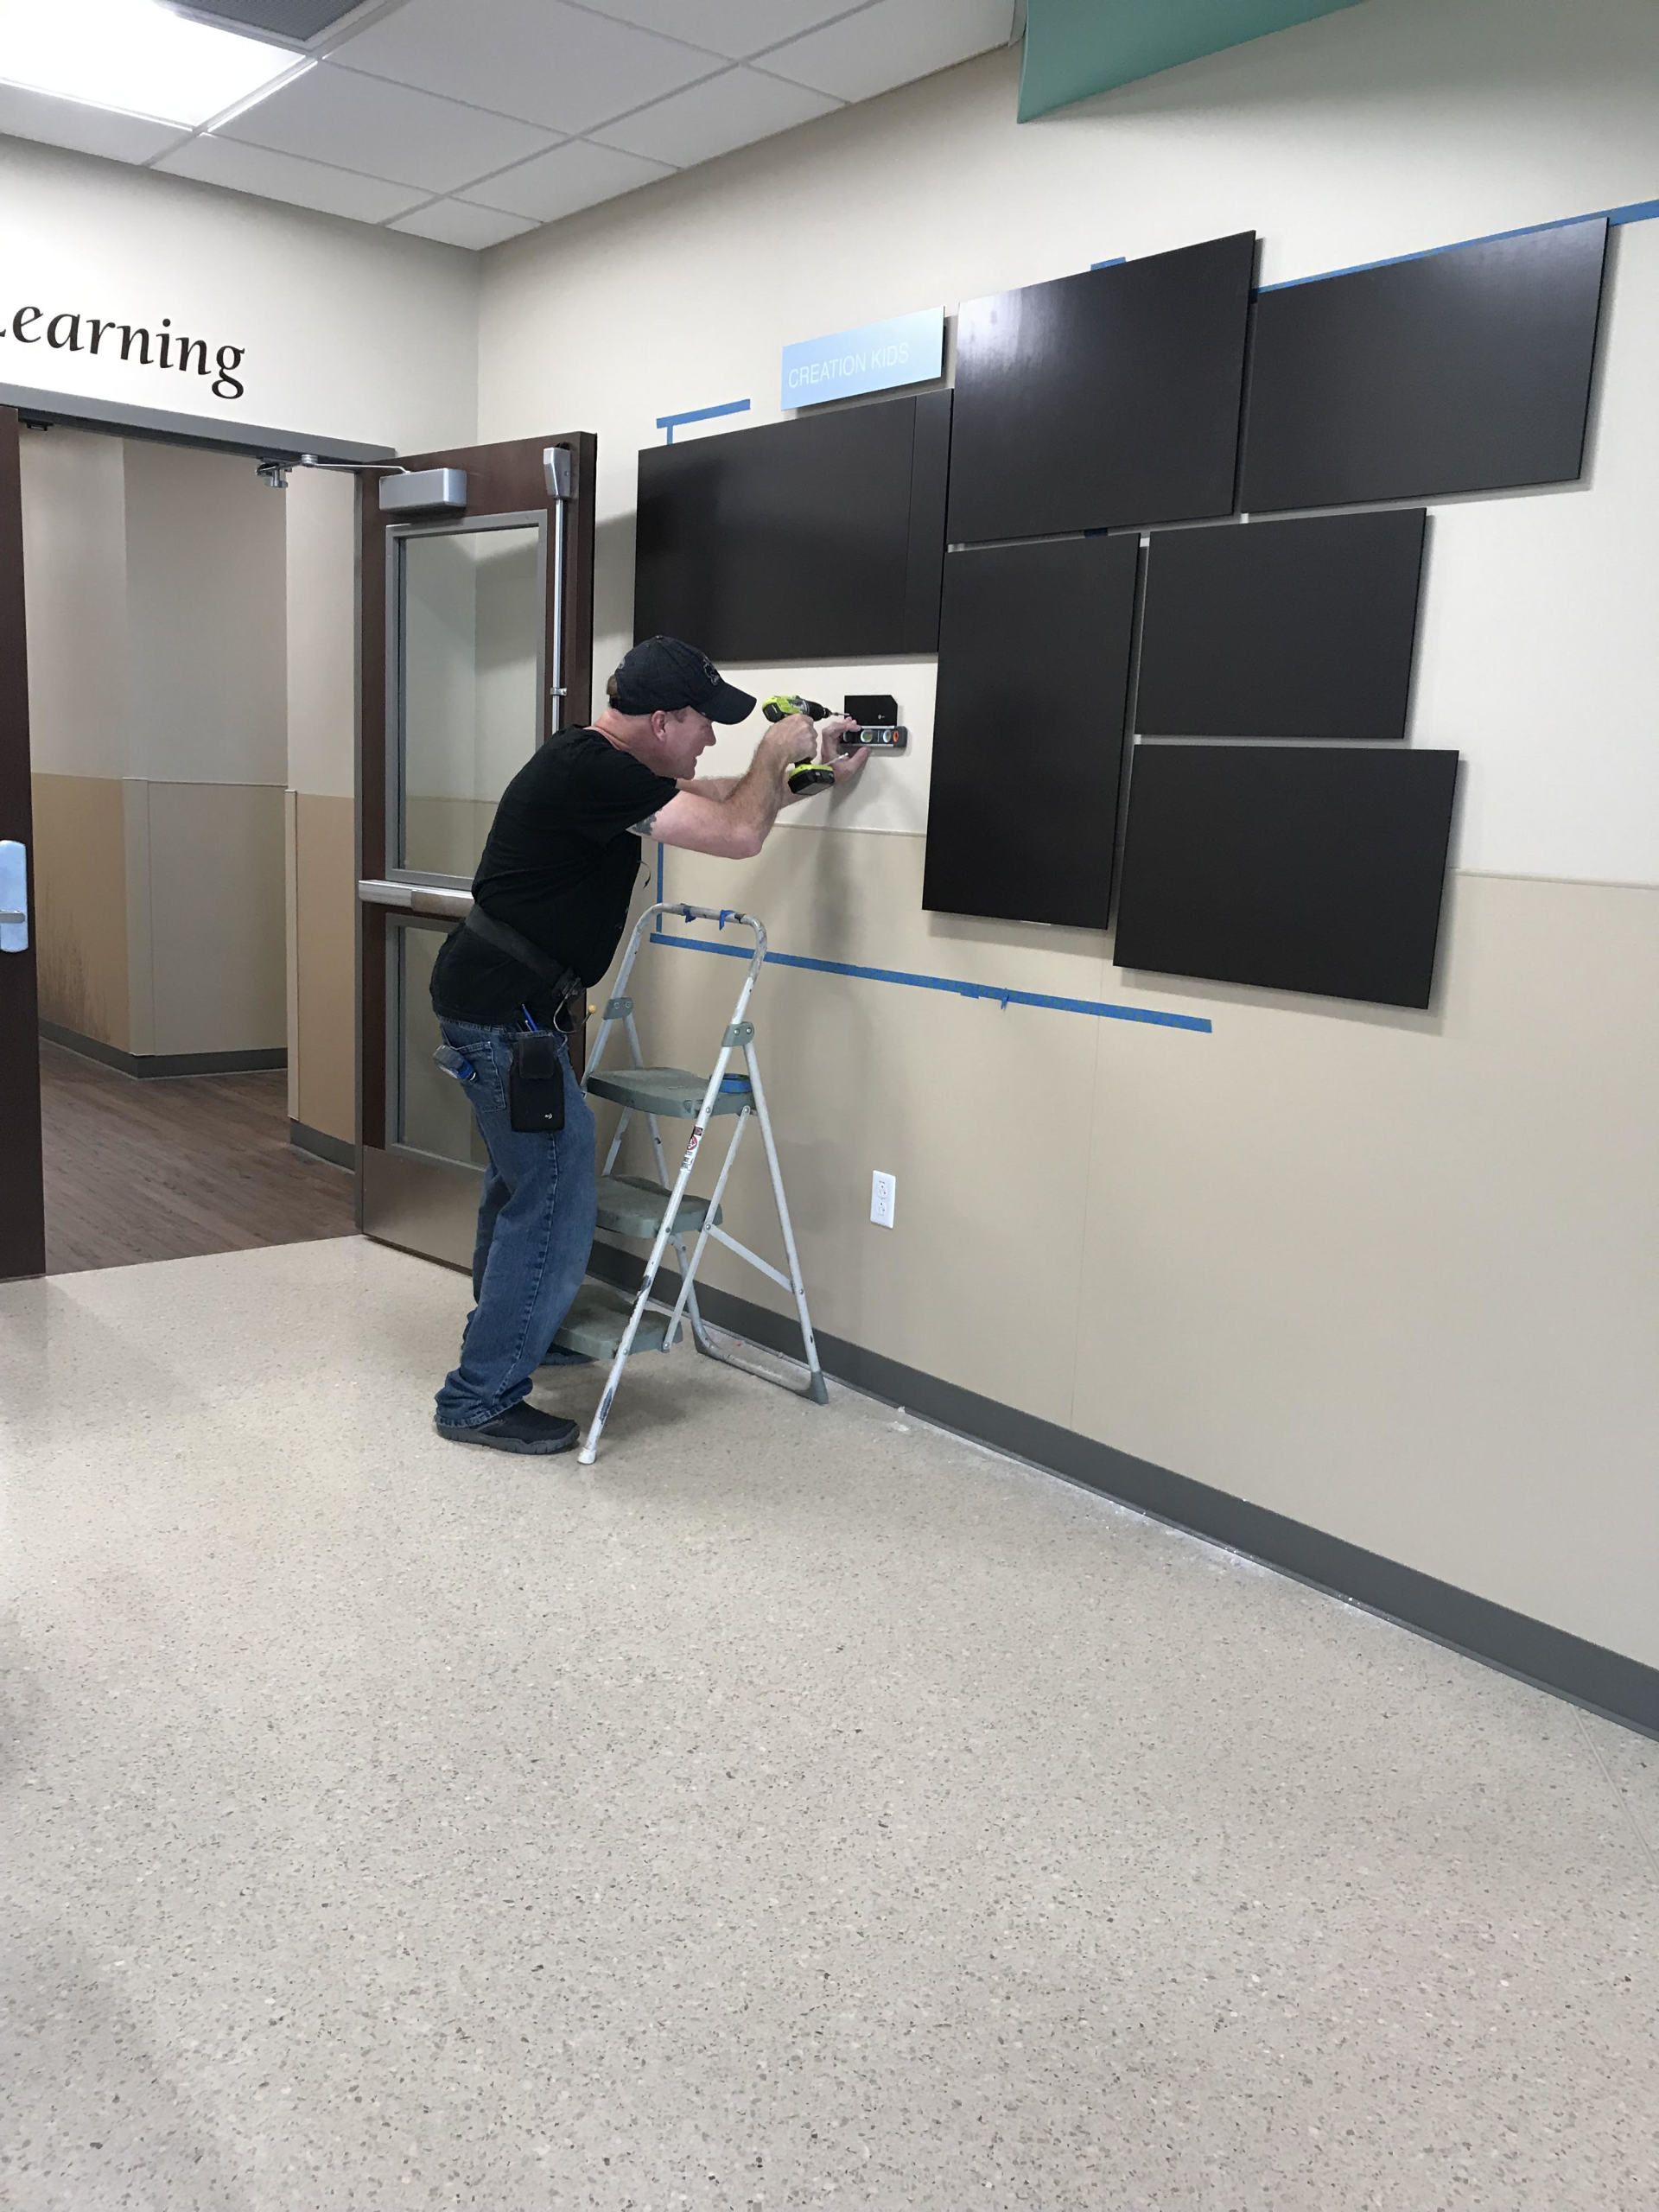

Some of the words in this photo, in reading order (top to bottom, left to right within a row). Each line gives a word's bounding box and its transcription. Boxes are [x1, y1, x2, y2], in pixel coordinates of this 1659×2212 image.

[0, 306, 245, 399] earning
[788, 352, 866, 389] CREATION
[871, 342, 910, 370] KIDS
